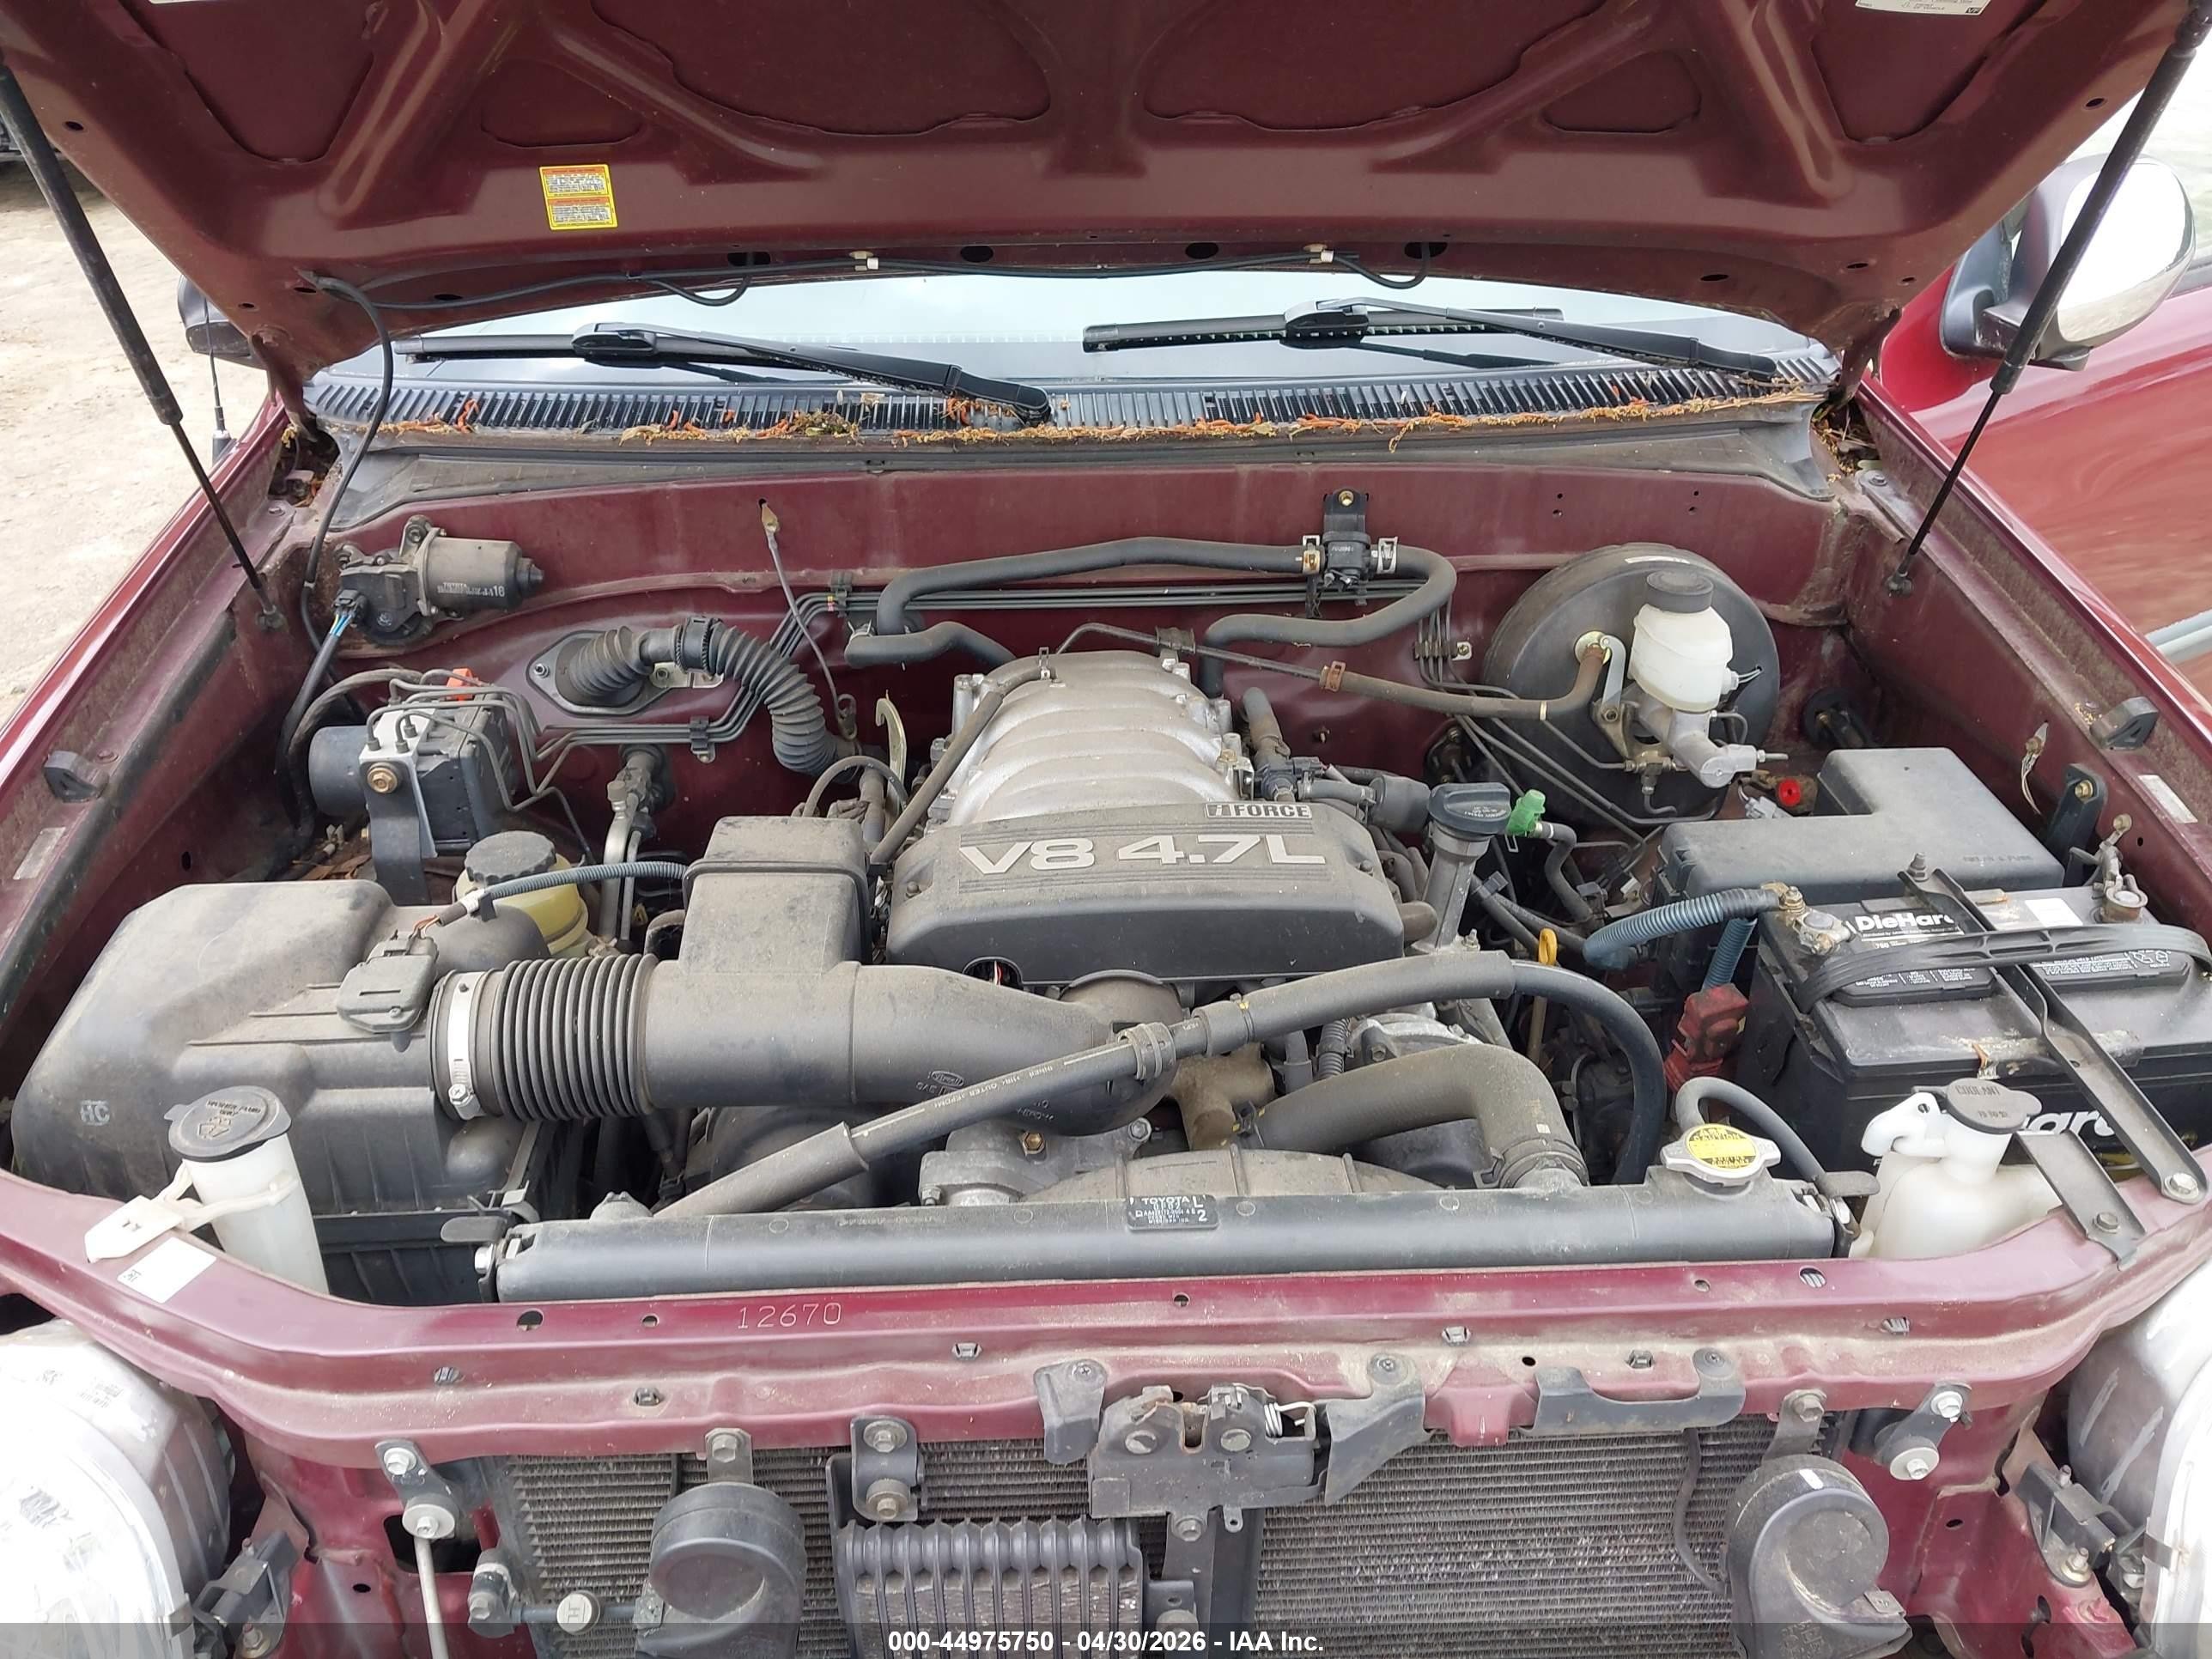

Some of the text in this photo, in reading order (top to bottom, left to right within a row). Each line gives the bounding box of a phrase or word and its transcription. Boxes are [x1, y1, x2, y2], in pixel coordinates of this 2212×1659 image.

[959, 835, 1326, 874] V8 4.7L
[1954, 1084, 2002, 1097] COOLANT
[1141, 1196, 1190, 1205] TOYOTA
[1197, 1209, 1208, 1222] 2
[738, 1302, 842, 1329] 12670
